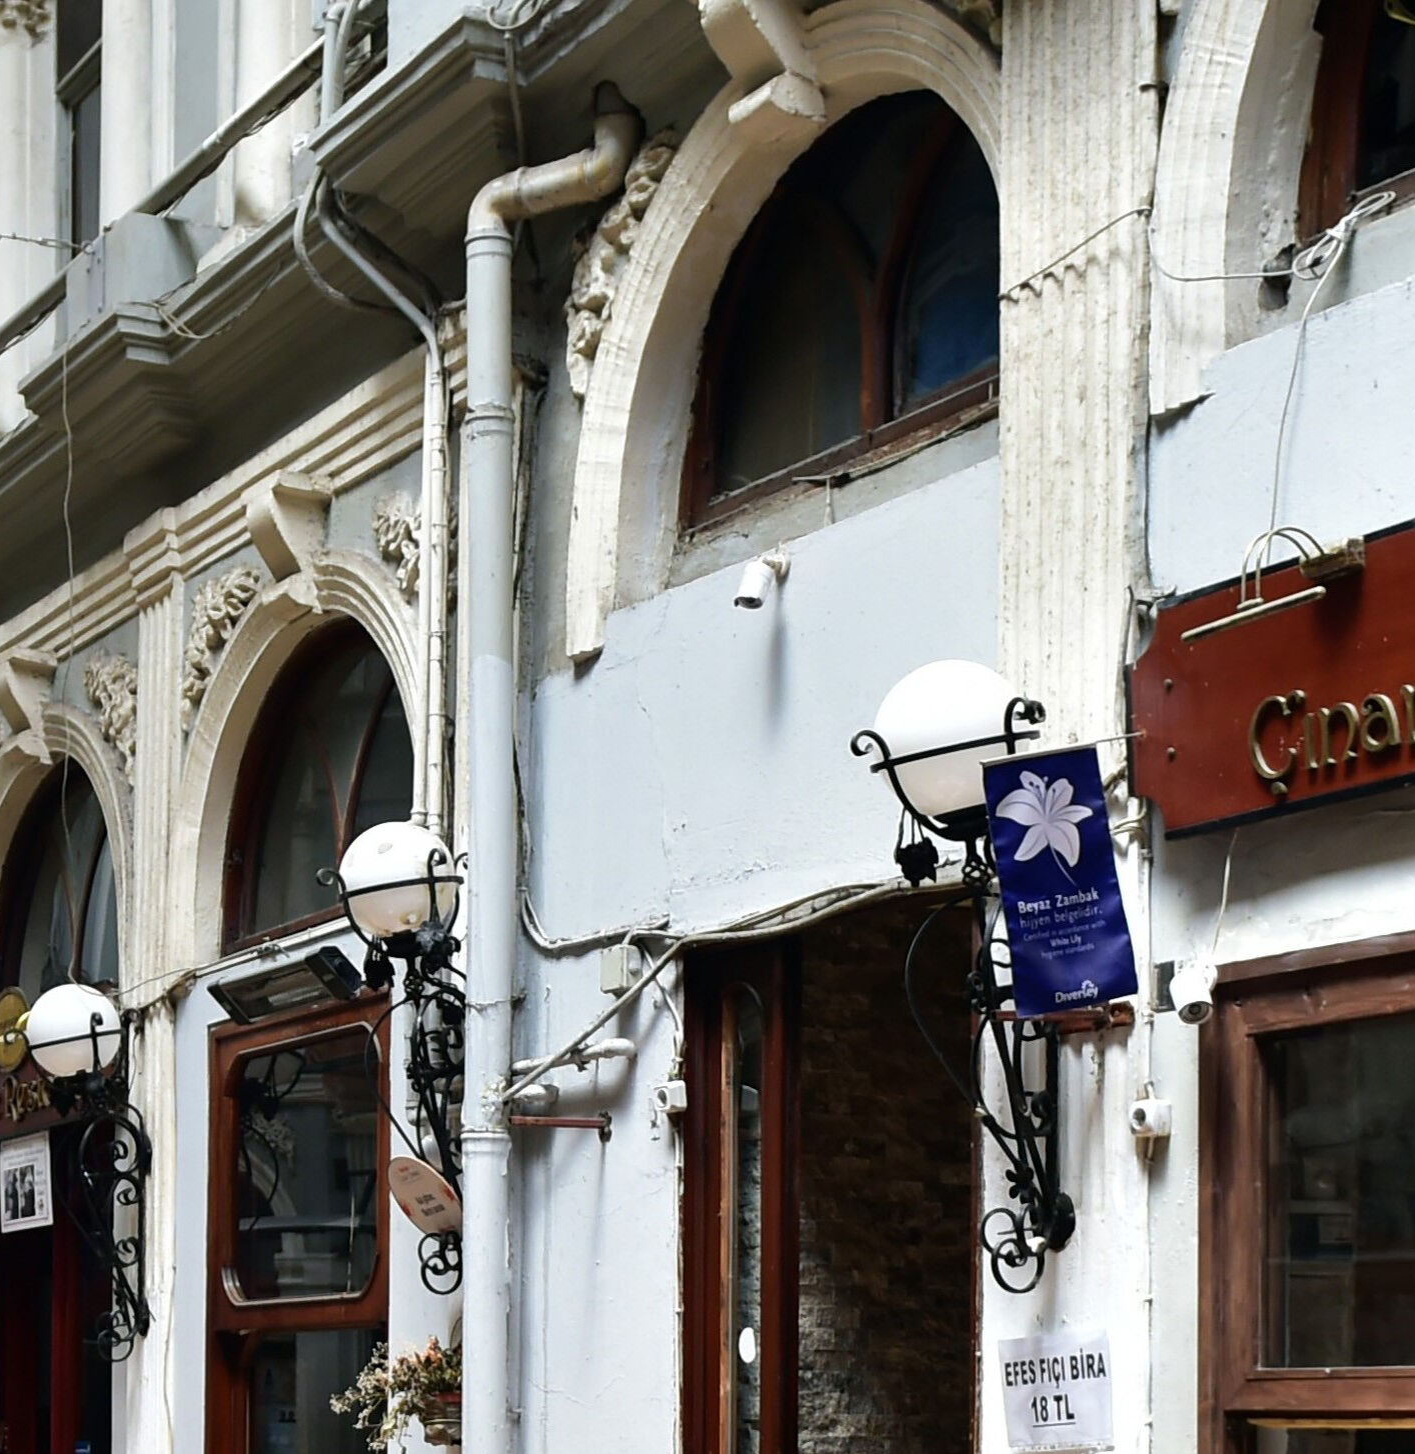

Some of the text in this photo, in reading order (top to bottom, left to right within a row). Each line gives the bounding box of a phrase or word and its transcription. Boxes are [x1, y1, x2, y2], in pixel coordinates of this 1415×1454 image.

[1017, 887, 1099, 915] Beyaz Zambak
[1019, 915, 1050, 930] hijyen
[1050, 938, 1069, 947] White
[1005, 1348, 1106, 1389] EFES FIÇI BİRA
[1031, 1394, 1075, 1423] 18 TL
